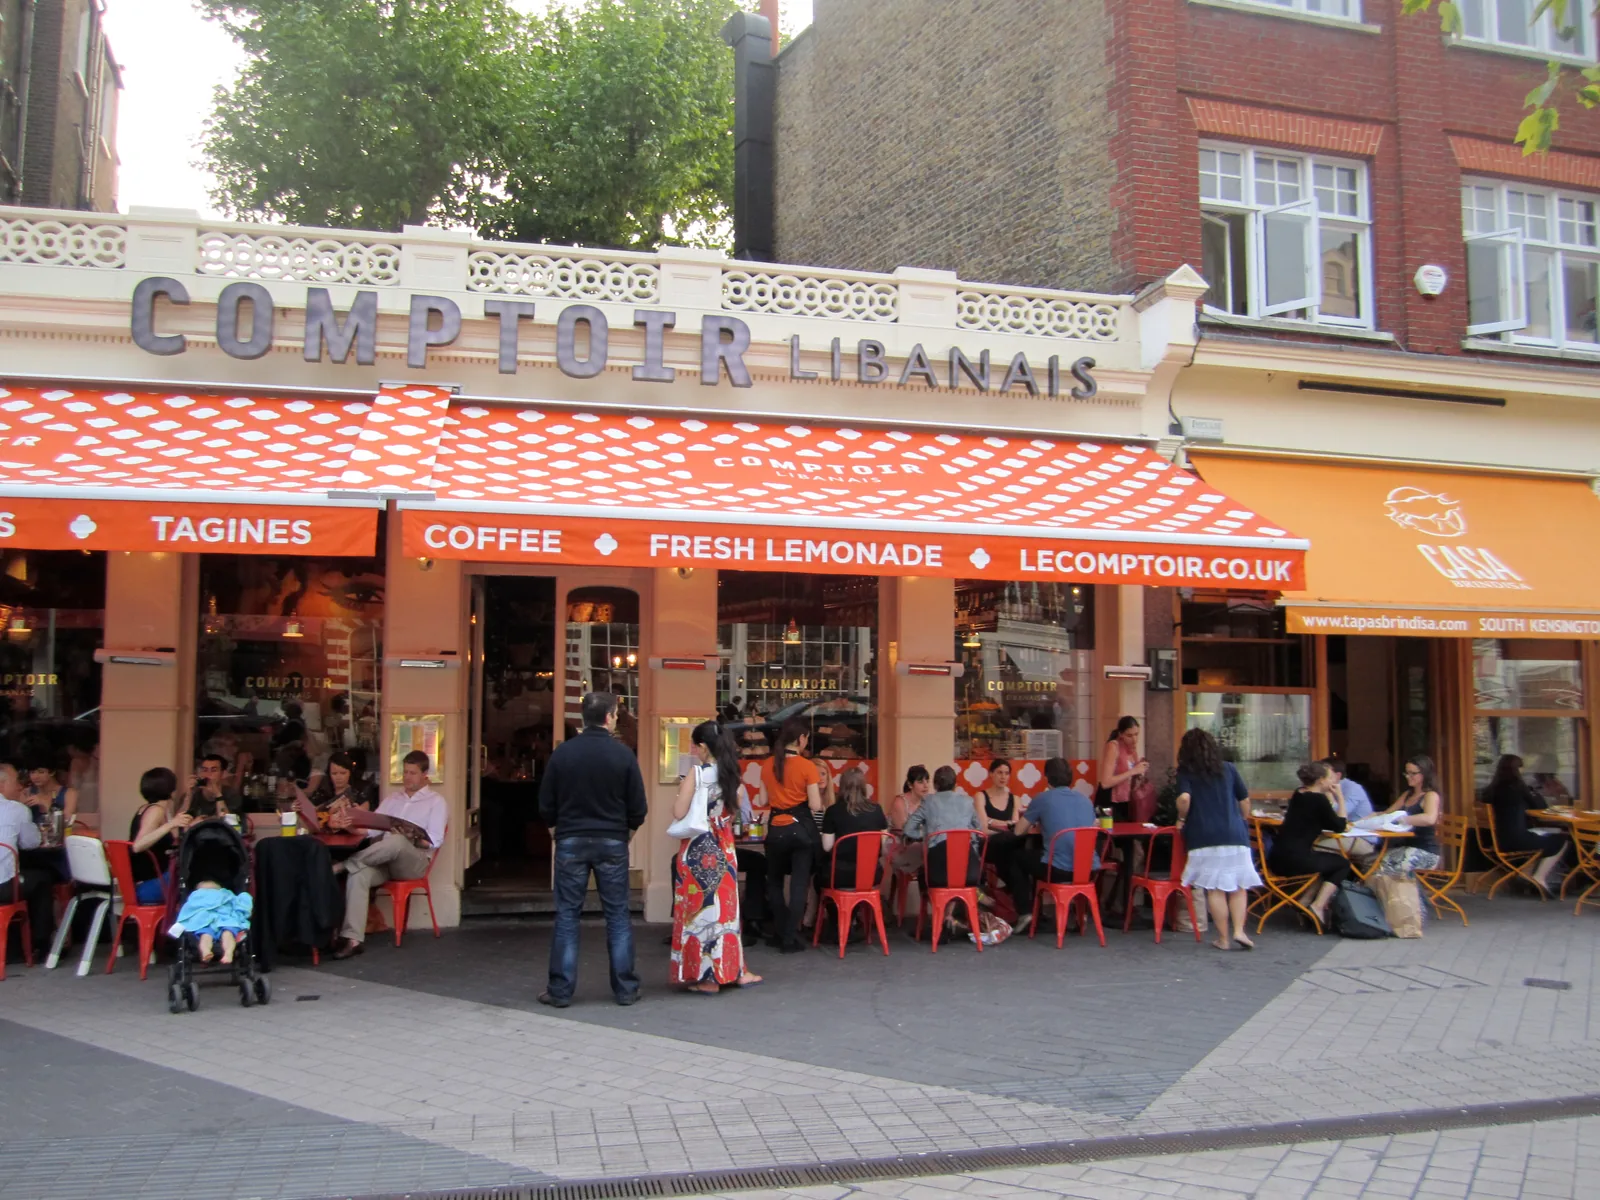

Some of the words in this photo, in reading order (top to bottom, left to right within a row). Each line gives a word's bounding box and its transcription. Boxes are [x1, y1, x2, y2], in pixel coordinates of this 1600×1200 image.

[131, 276, 753, 387] COMPTOIR
[790, 334, 1098, 399] LIBANAIS
[714, 456, 924, 474] COMPTOIR
[775, 470, 882, 483] LIBANAIS
[151, 516, 312, 545] TAGINES
[424, 524, 562, 553] COFFEE
[650, 533, 754, 560] FRESH
[766, 538, 942, 567] LEMONADE
[1020, 550, 1292, 582] LECOMPTOIR.CO.UK
[1417, 544, 1522, 581] CASA
[1451, 580, 1534, 590] BRINDISA
[1303, 615, 1468, 631] www.tapasbrindisa.com
[1479, 618, 1525, 632] SOUTH
[245, 676, 332, 689] COMPTOIR
[761, 679, 836, 689] COMPTOIR
[987, 680, 1057, 692] COMPTOIR
